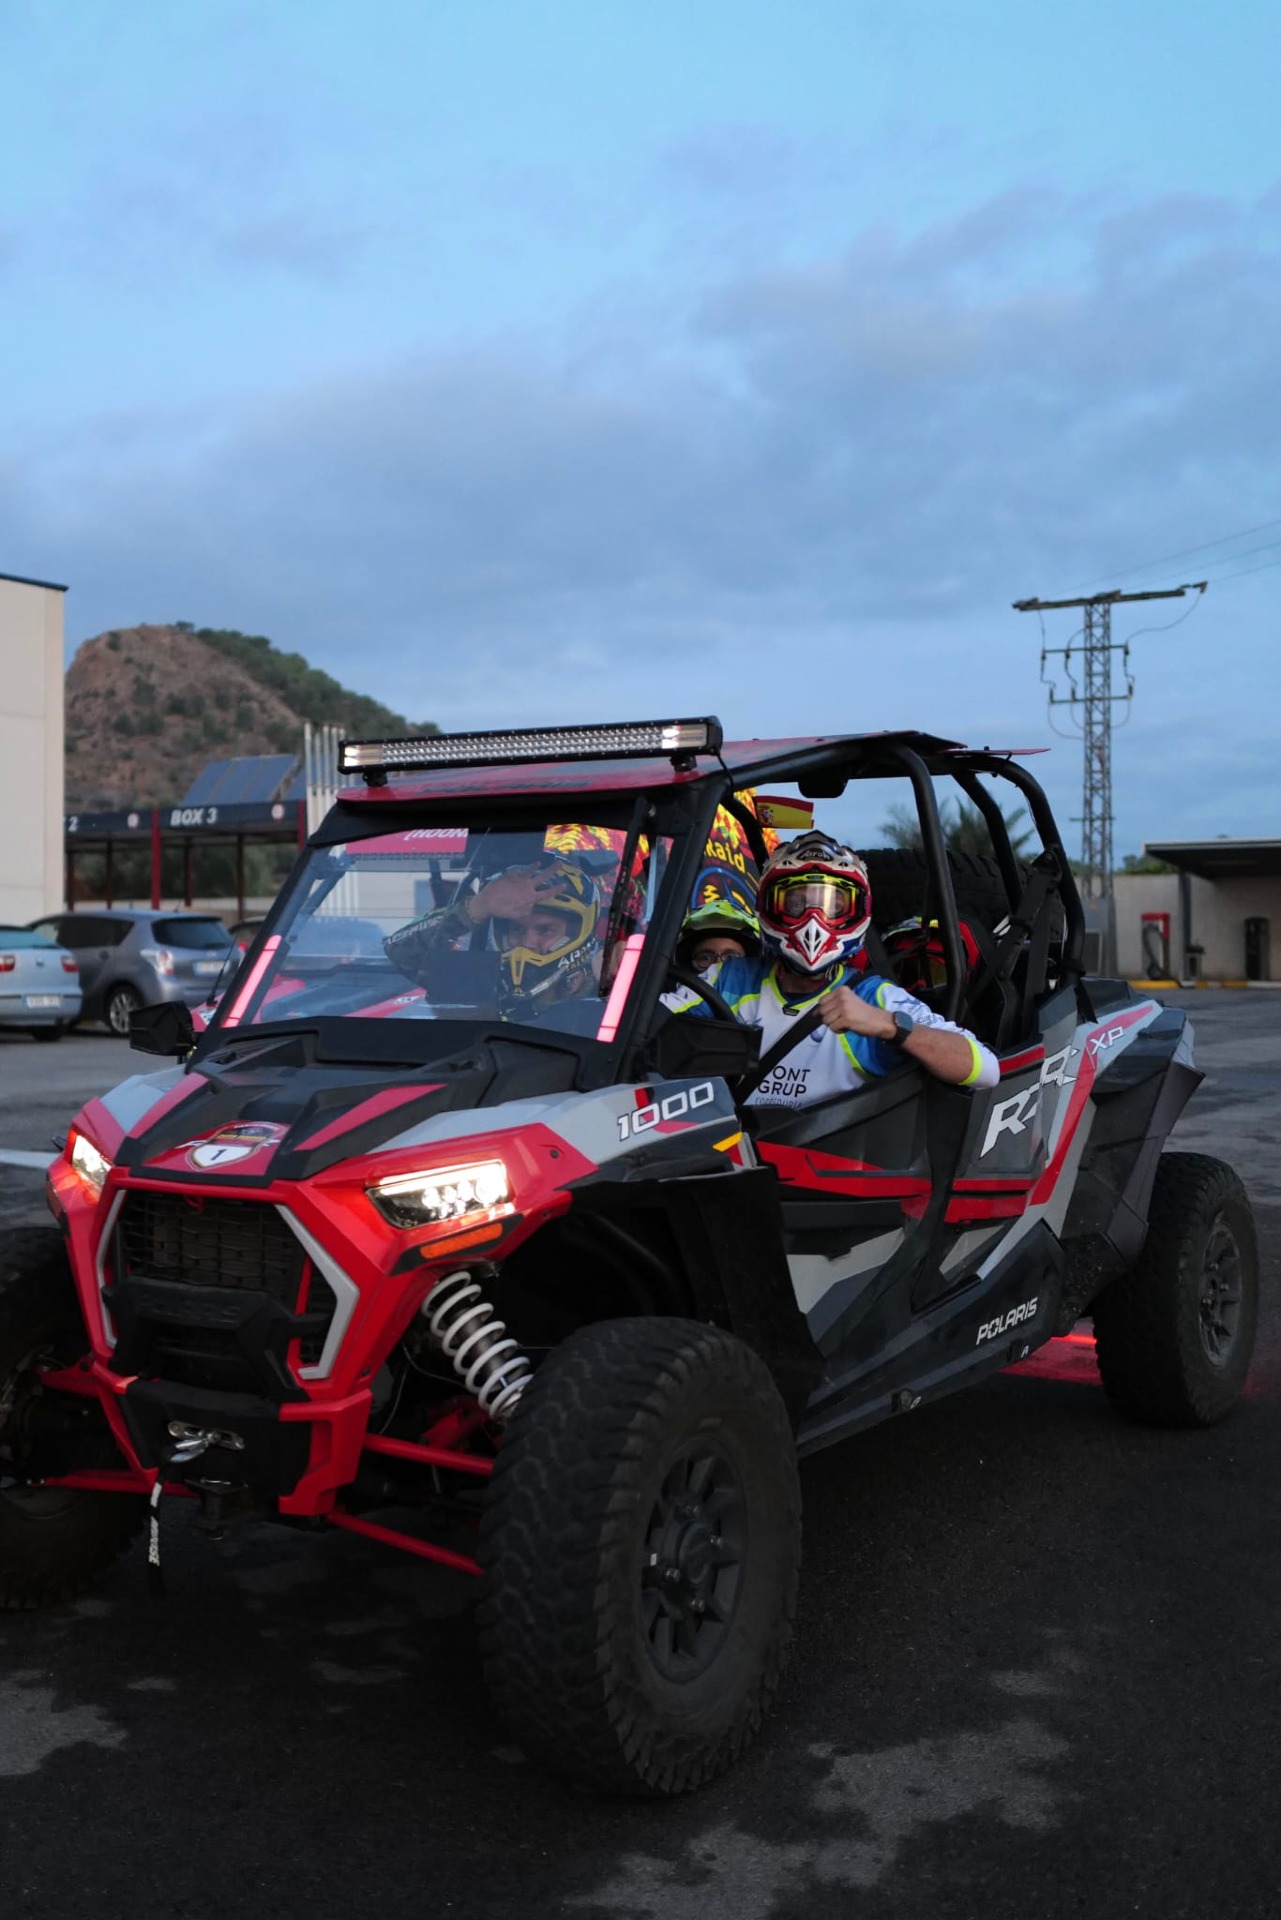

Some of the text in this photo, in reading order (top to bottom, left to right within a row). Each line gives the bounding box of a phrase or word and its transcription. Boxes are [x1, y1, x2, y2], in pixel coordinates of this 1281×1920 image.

[68, 816, 79, 833] 2
[170, 807, 218, 826] BOX 3
[1090, 1025, 1125, 1055] XP
[772, 1065, 811, 1083] ONT
[757, 1080, 807, 1098] GRUP
[617, 1081, 714, 1141] 1000
[210, 1148, 228, 1161] 1
[976, 1296, 1039, 1346] POLARIS
